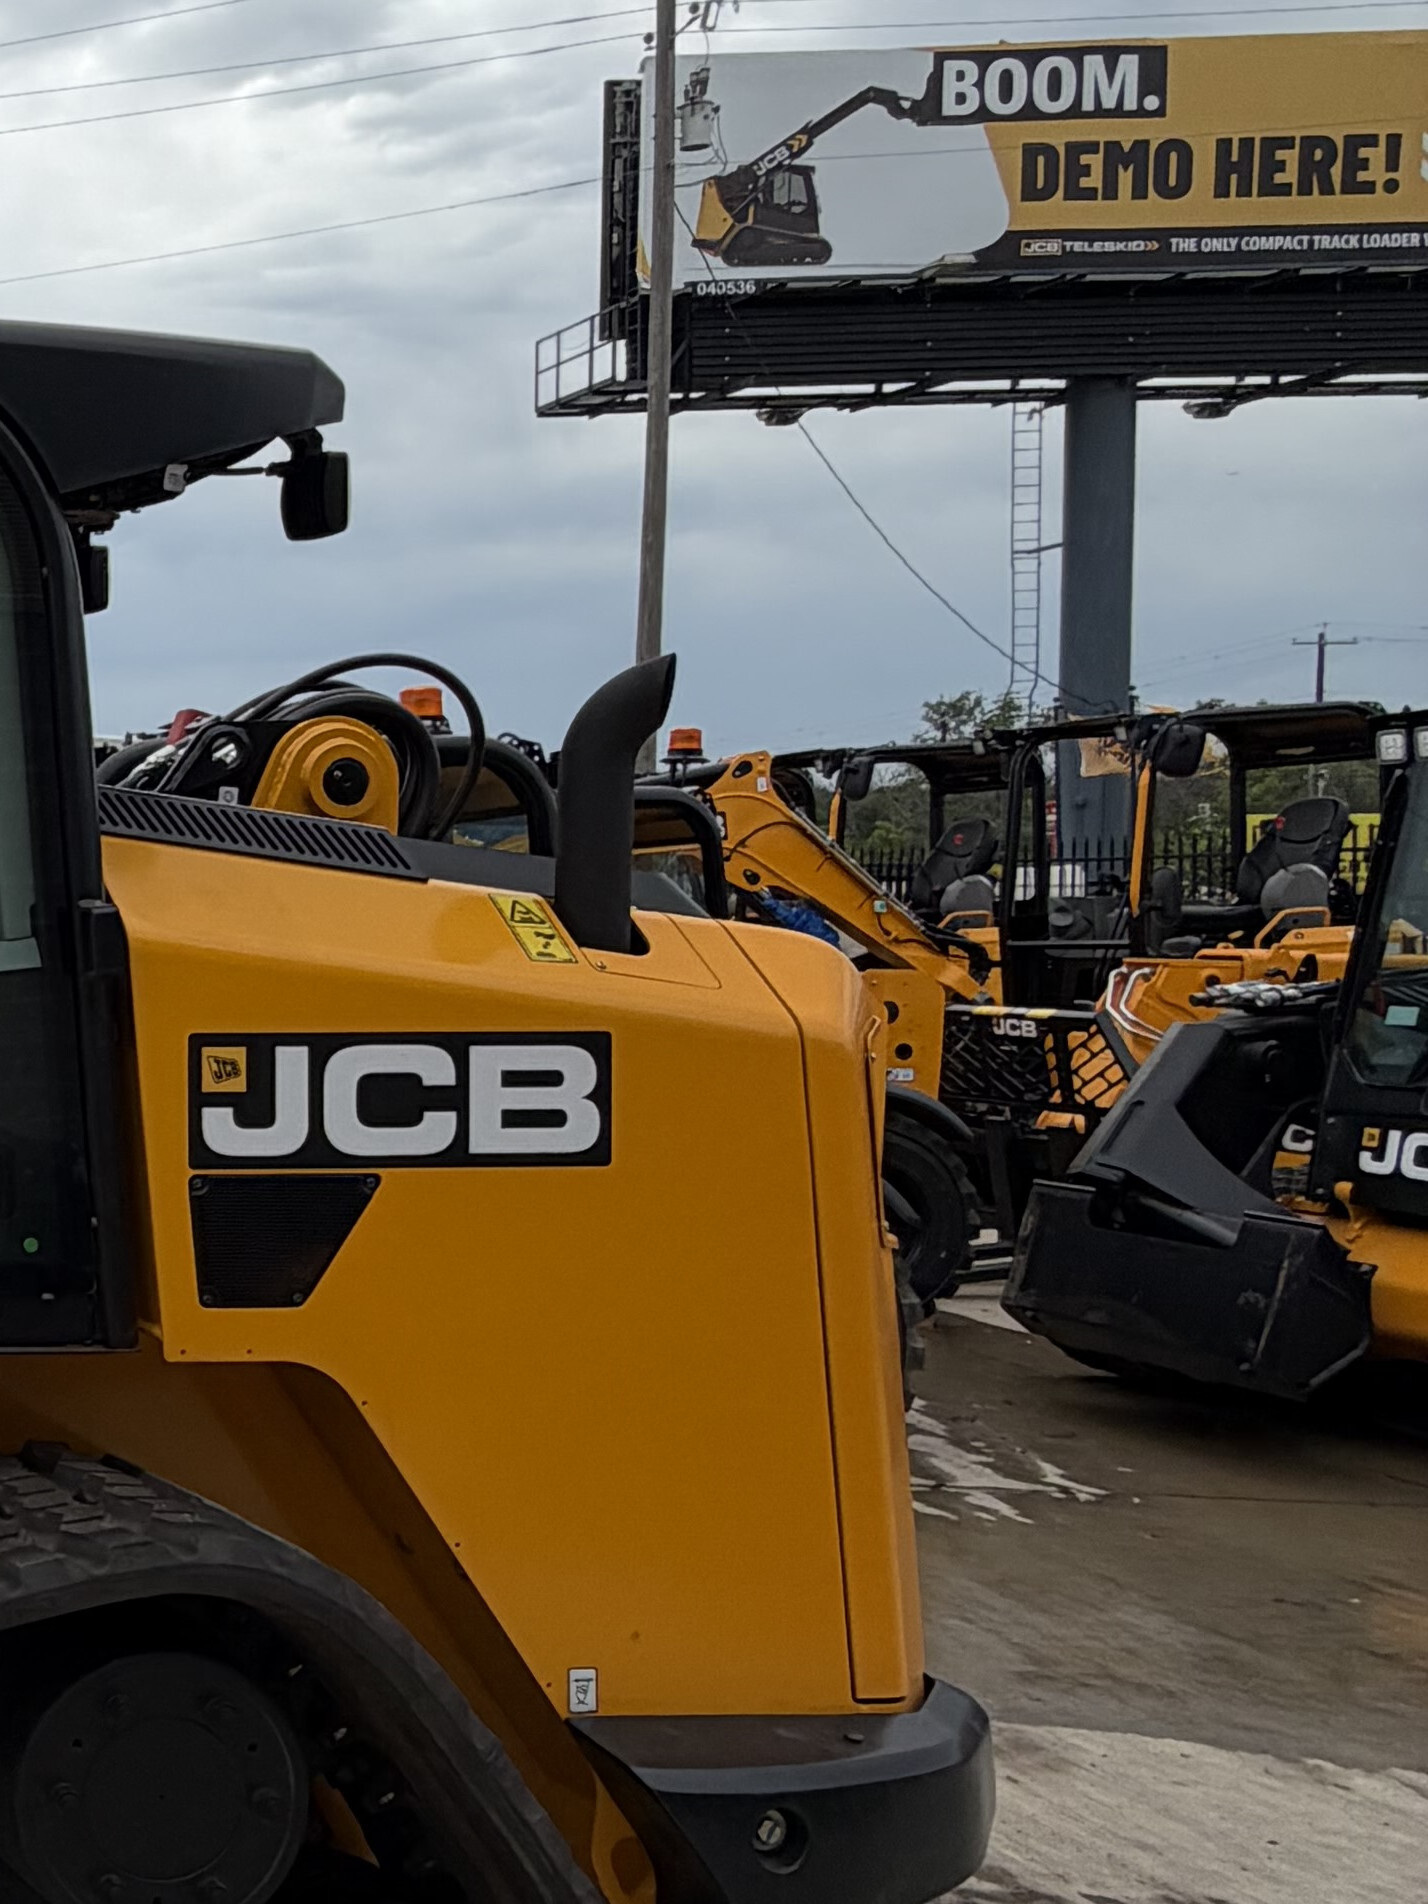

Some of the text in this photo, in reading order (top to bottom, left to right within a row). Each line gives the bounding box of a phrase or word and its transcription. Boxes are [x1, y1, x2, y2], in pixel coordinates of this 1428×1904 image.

[941, 53, 1160, 116] BOOM.
[753, 145, 791, 176] JCB
[1021, 133, 1402, 202] DEMO HERE!
[1064, 240, 1145, 252] TELESKID
[1170, 237, 1197, 252] THE
[1201, 237, 1238, 252] ONLY
[1241, 235, 1310, 251] COMPACT
[1313, 234, 1360, 250] TRACK
[1363, 233, 1421, 248] LOADER
[696, 280, 756, 295] 040536
[993, 1018, 1038, 1038] JCB
[201, 1044, 601, 1157] JCB
